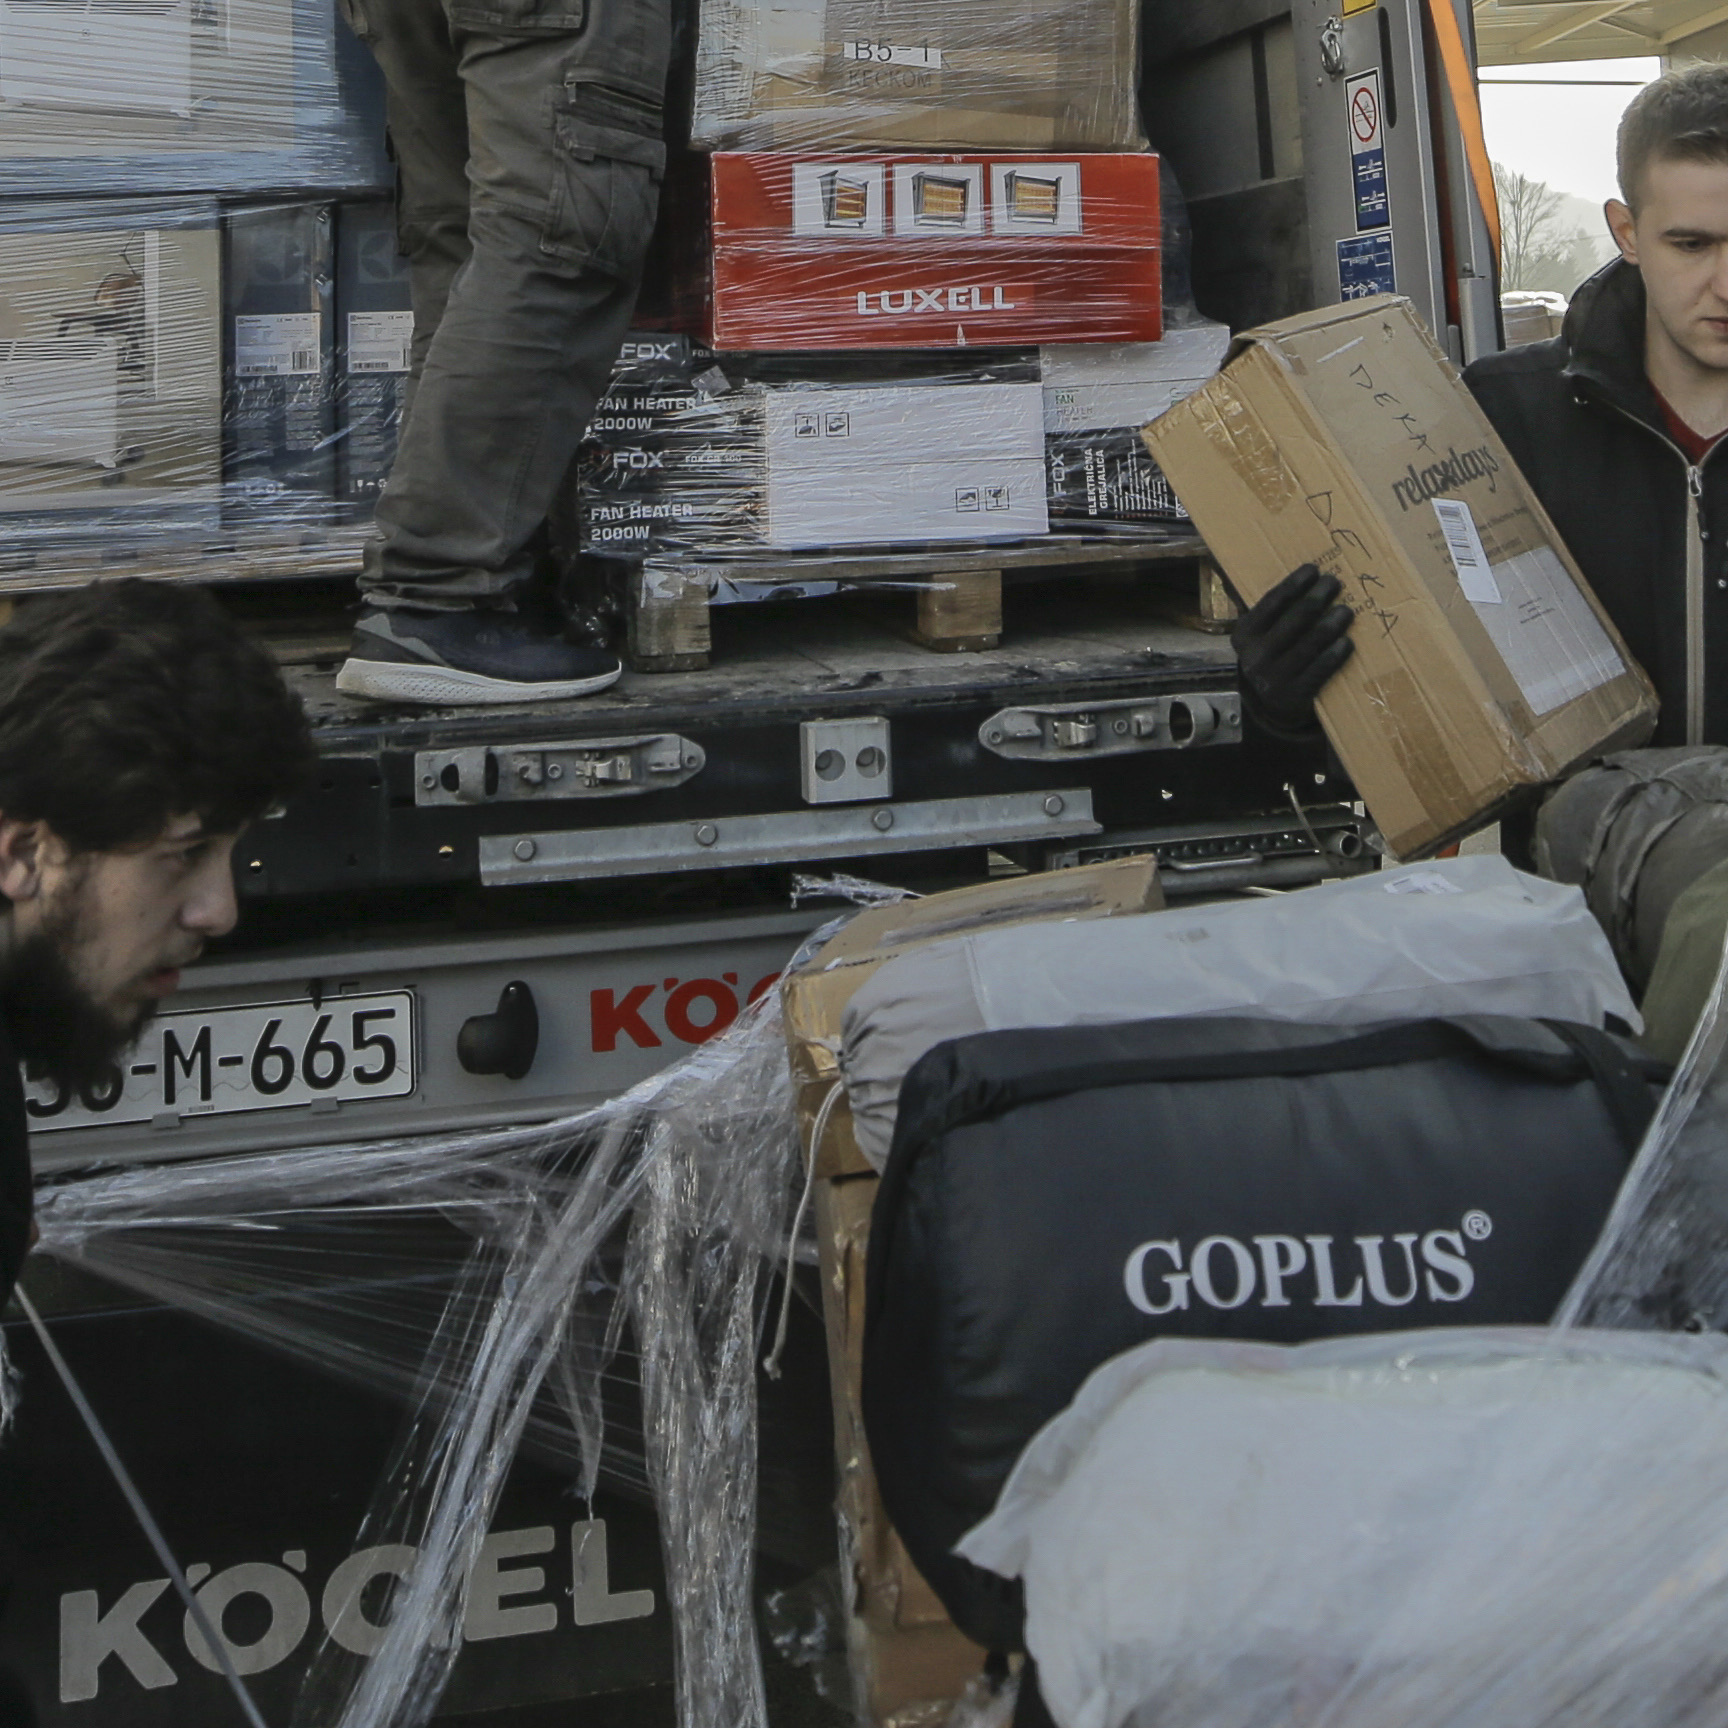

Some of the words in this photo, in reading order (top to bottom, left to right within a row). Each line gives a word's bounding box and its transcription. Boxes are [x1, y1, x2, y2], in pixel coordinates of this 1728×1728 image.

[857, 286, 1015, 315] LUXELL
[621, 343, 672, 360] FOX
[596, 398, 628, 411] FAN
[633, 397, 697, 410] HEATER
[1055, 394, 1074, 404] FAN
[594, 417, 652, 430] 2000W
[613, 451, 665, 469] FOX
[1051, 453, 1066, 497] FOX
[1096, 449, 1109, 509] GREJALICA
[590, 505, 624, 520] FAN
[630, 503, 694, 519] HEATER
[590, 972, 784, 1052] KÖ
